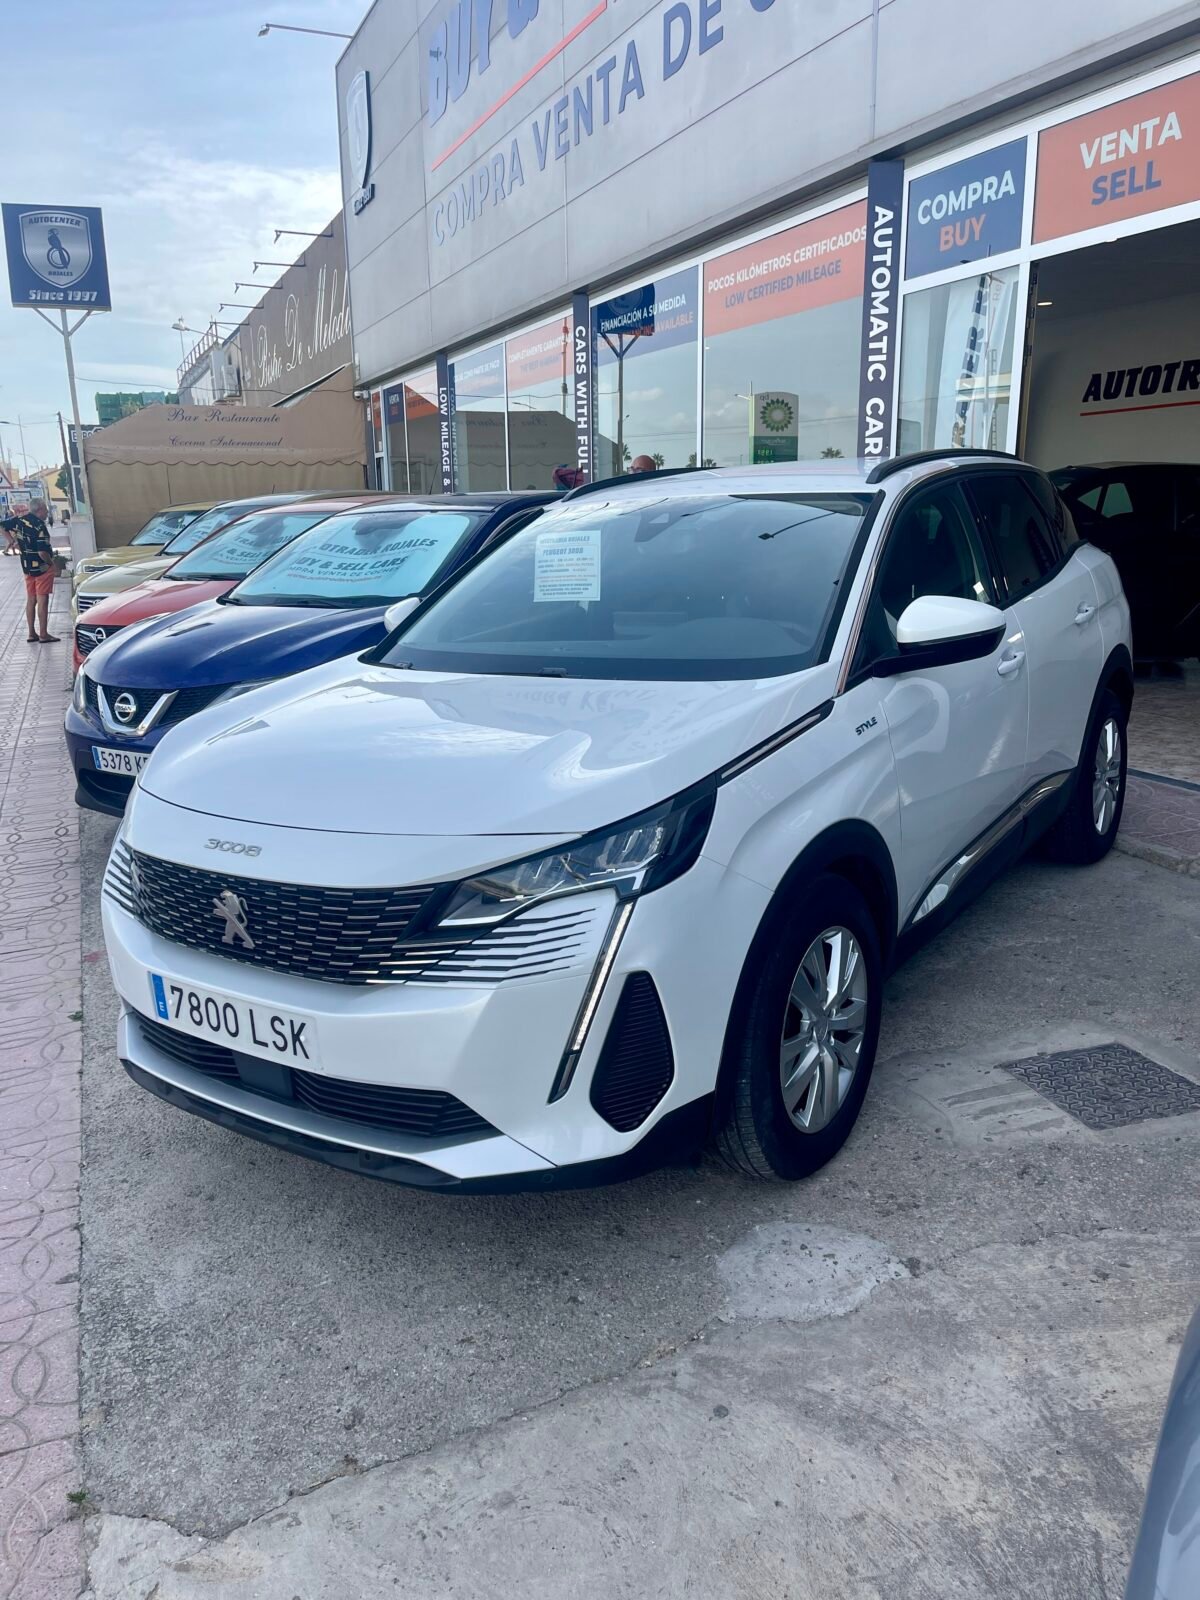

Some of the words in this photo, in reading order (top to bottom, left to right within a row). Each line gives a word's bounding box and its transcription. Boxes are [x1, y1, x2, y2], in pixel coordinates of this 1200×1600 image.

[435, 138, 525, 246] COMPRA
[532, 40, 645, 171] VENTA
[1080, 111, 1183, 169] VENTA
[917, 169, 1016, 225] COMPRA
[1091, 160, 1162, 206] SELL
[28, 216, 81, 227] AUTOCENTER
[939, 213, 986, 252] BUY
[708, 273, 735, 293] POCOS
[736, 252, 792, 281] KILÓMETROS
[793, 225, 867, 264] CERTIFICADOS
[28, 289, 64, 301] Since
[66, 291, 98, 302] 1997
[725, 291, 746, 309] LOW
[747, 275, 794, 301] CERTIFIED
[796, 259, 842, 286] MILEAGE
[867, 205, 894, 382] AUTOMATIC
[601, 308, 642, 333] FINANCIACIÓN
[642, 310, 649, 320] A
[649, 302, 657, 317] SU
[658, 293, 687, 315] MEDIDA
[575, 325, 587, 375] CARS
[168, 407, 199, 422] Bar
[205, 408, 281, 424] Restaurante
[439, 387, 448, 416] LOW
[576, 380, 588, 429] WITH
[169, 434, 206, 447] Cocina
[210, 435, 284, 447] Internacional
[440, 421, 451, 473] MILEAGE
[443, 478, 451, 486] &
[333, 561, 368, 571] SELL
[369, 555, 409, 570] CARS
[382, 538, 439, 553] ROJALES
[855, 716, 878, 736] STYLE
[100, 750, 132, 772] 5378
[204, 837, 263, 858] 3008
[158, 1001, 165, 1012] E
[170, 984, 240, 1038] 7800
[248, 1007, 310, 1060] LSK
